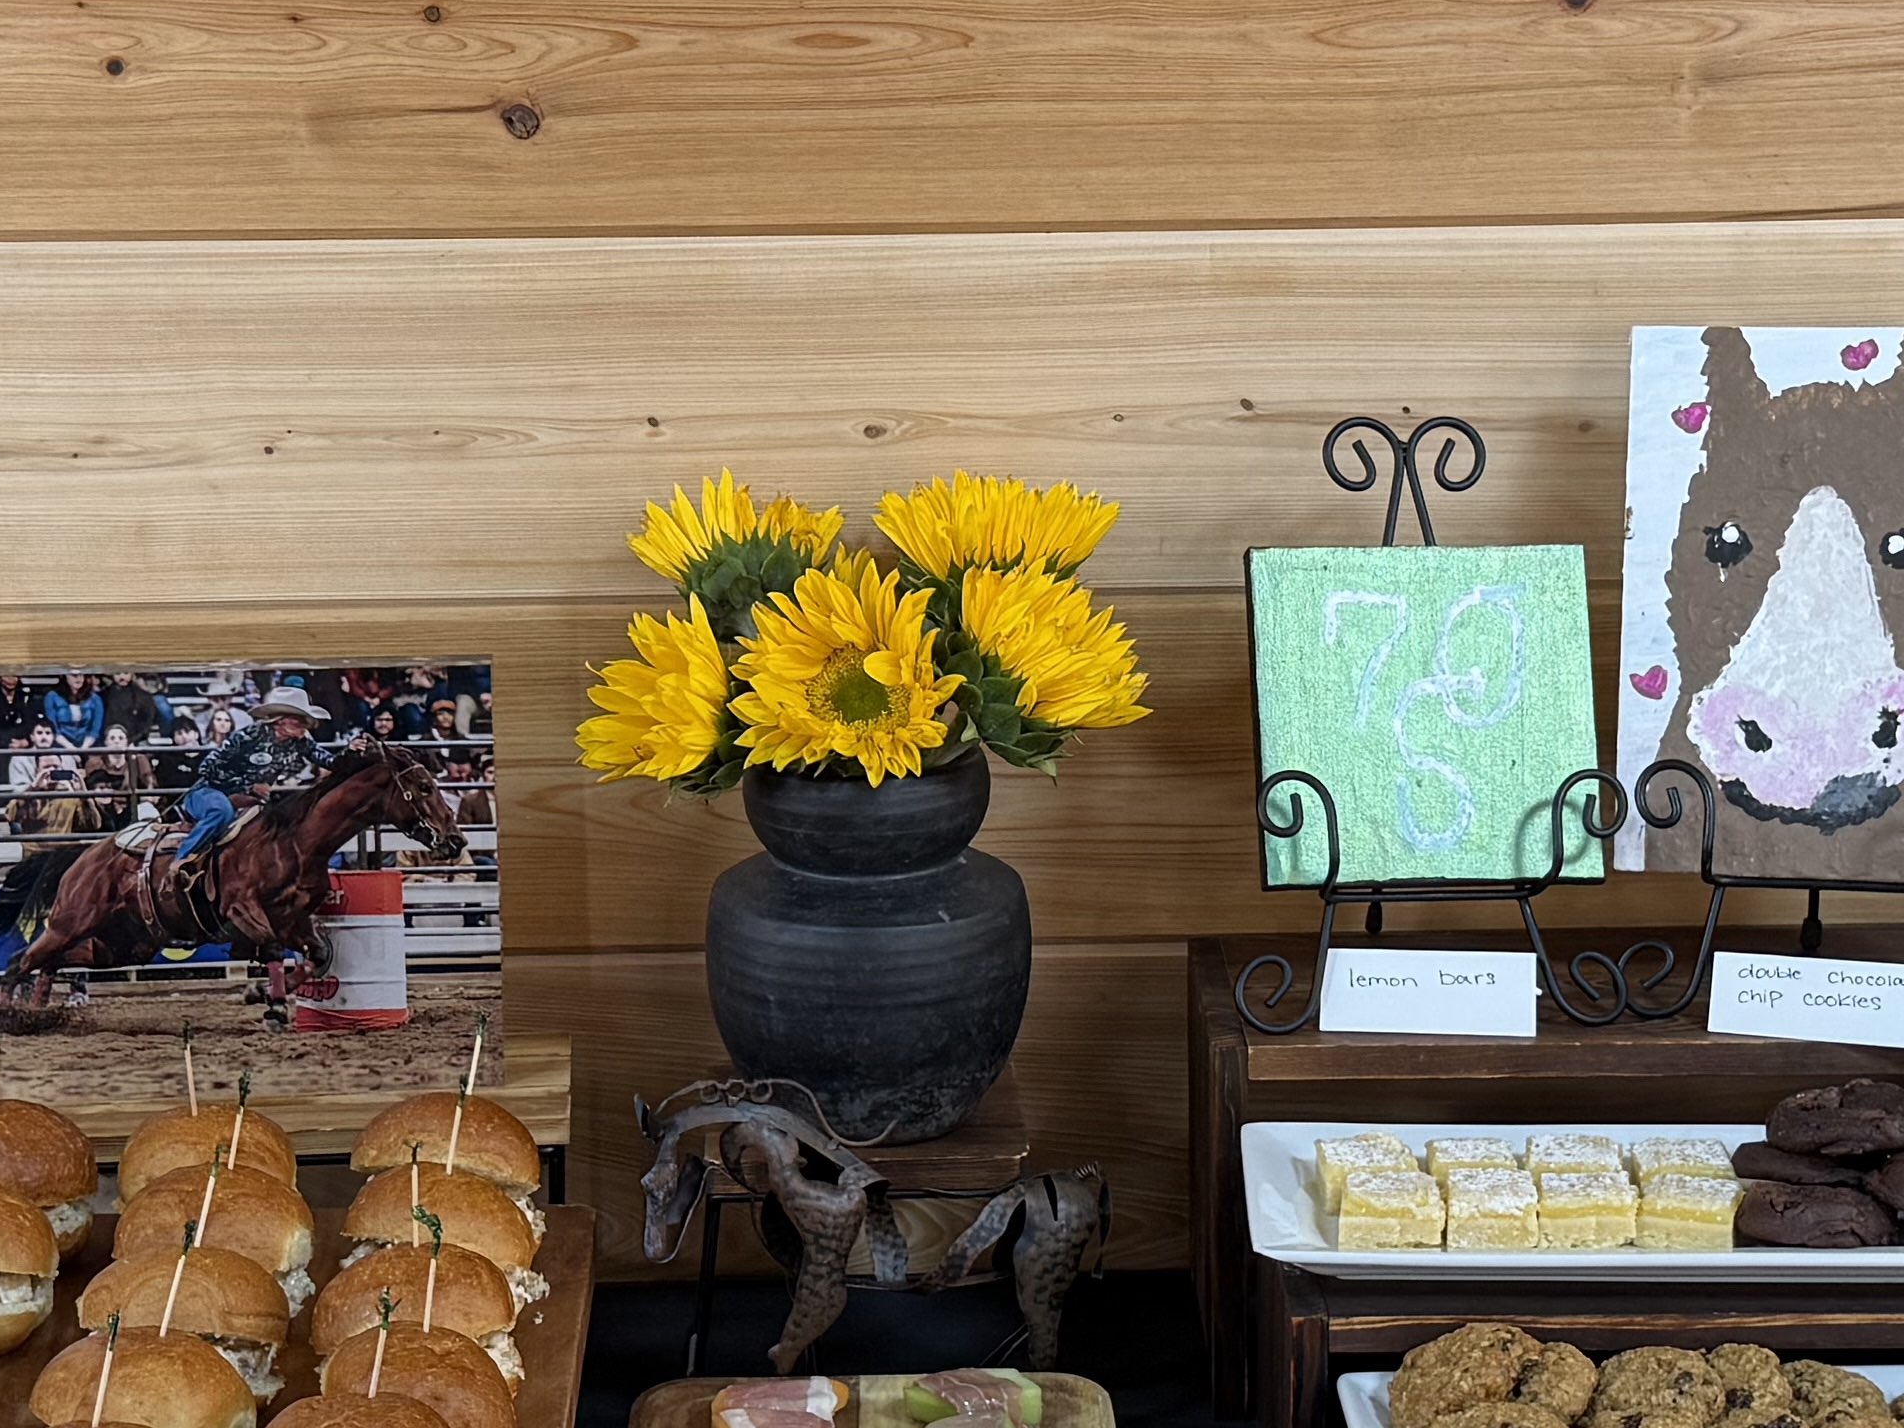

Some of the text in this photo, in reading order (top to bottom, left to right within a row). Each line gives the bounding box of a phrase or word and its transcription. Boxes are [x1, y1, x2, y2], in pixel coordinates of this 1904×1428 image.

[1349, 967, 1496, 988] lemon bars
[1737, 963, 1801, 980] double
[1802, 992, 1882, 1011] cookies
